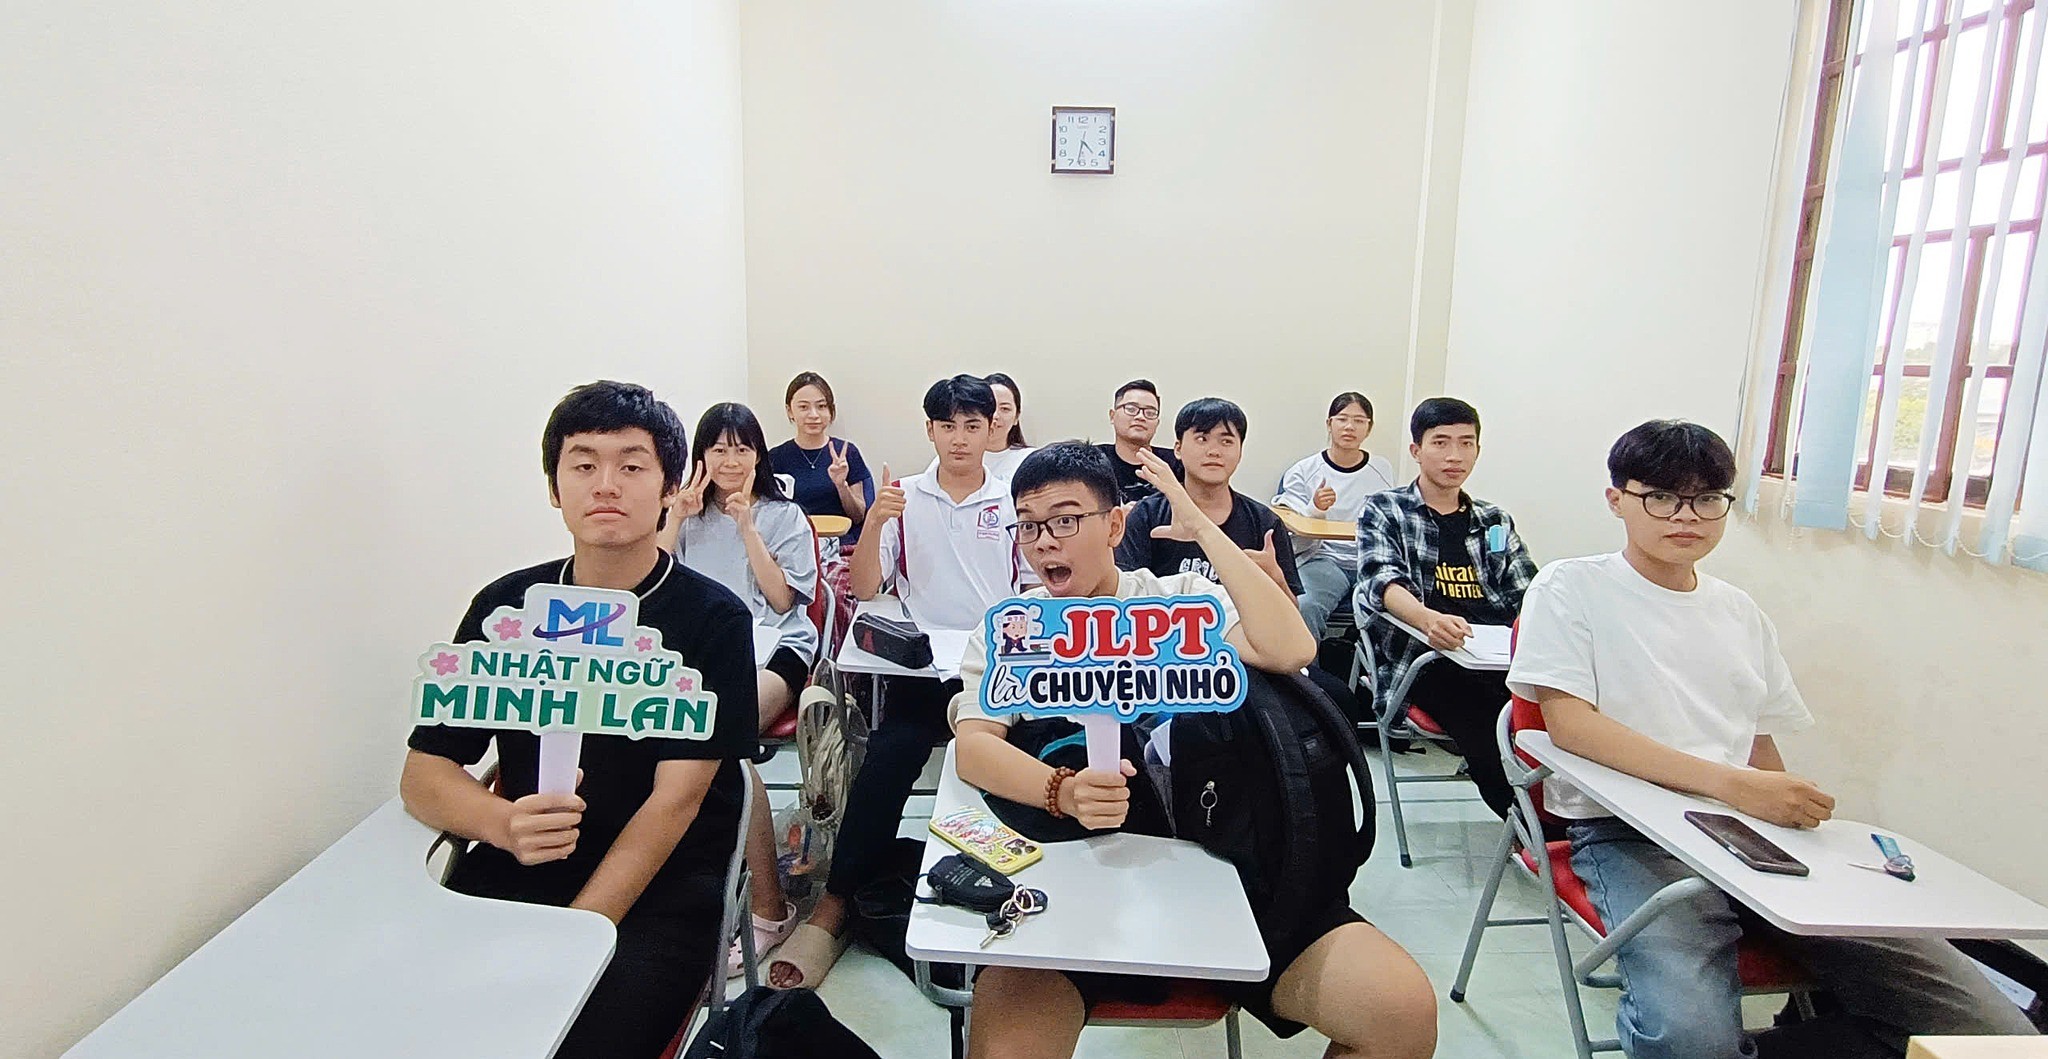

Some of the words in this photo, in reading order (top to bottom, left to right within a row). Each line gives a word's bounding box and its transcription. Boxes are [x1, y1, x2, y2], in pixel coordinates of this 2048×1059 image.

[1067, 115, 1074, 123] 11
[1078, 115, 1089, 124] 12
[1058, 125, 1068, 134] 10
[1098, 125, 1107, 134] 2
[1059, 137, 1068, 145] 9
[1098, 137, 1107, 146] 3
[1059, 149, 1067, 157] 8
[1067, 158, 1074, 167] 7
[1090, 158, 1099, 167] 5
[1448, 583, 1485, 599] BETTER
[541, 597, 626, 647] ML
[1053, 607, 1214, 658] JLPT
[470, 649, 580, 686] NHẬT
[588, 657, 675, 687] NGỮ
[991, 664, 1027, 703] là
[1029, 659, 1158, 711] CHUYỆN
[1166, 656, 1236, 700] NHỎ
[420, 683, 579, 728] MINH
[600, 692, 709, 733] LAN
